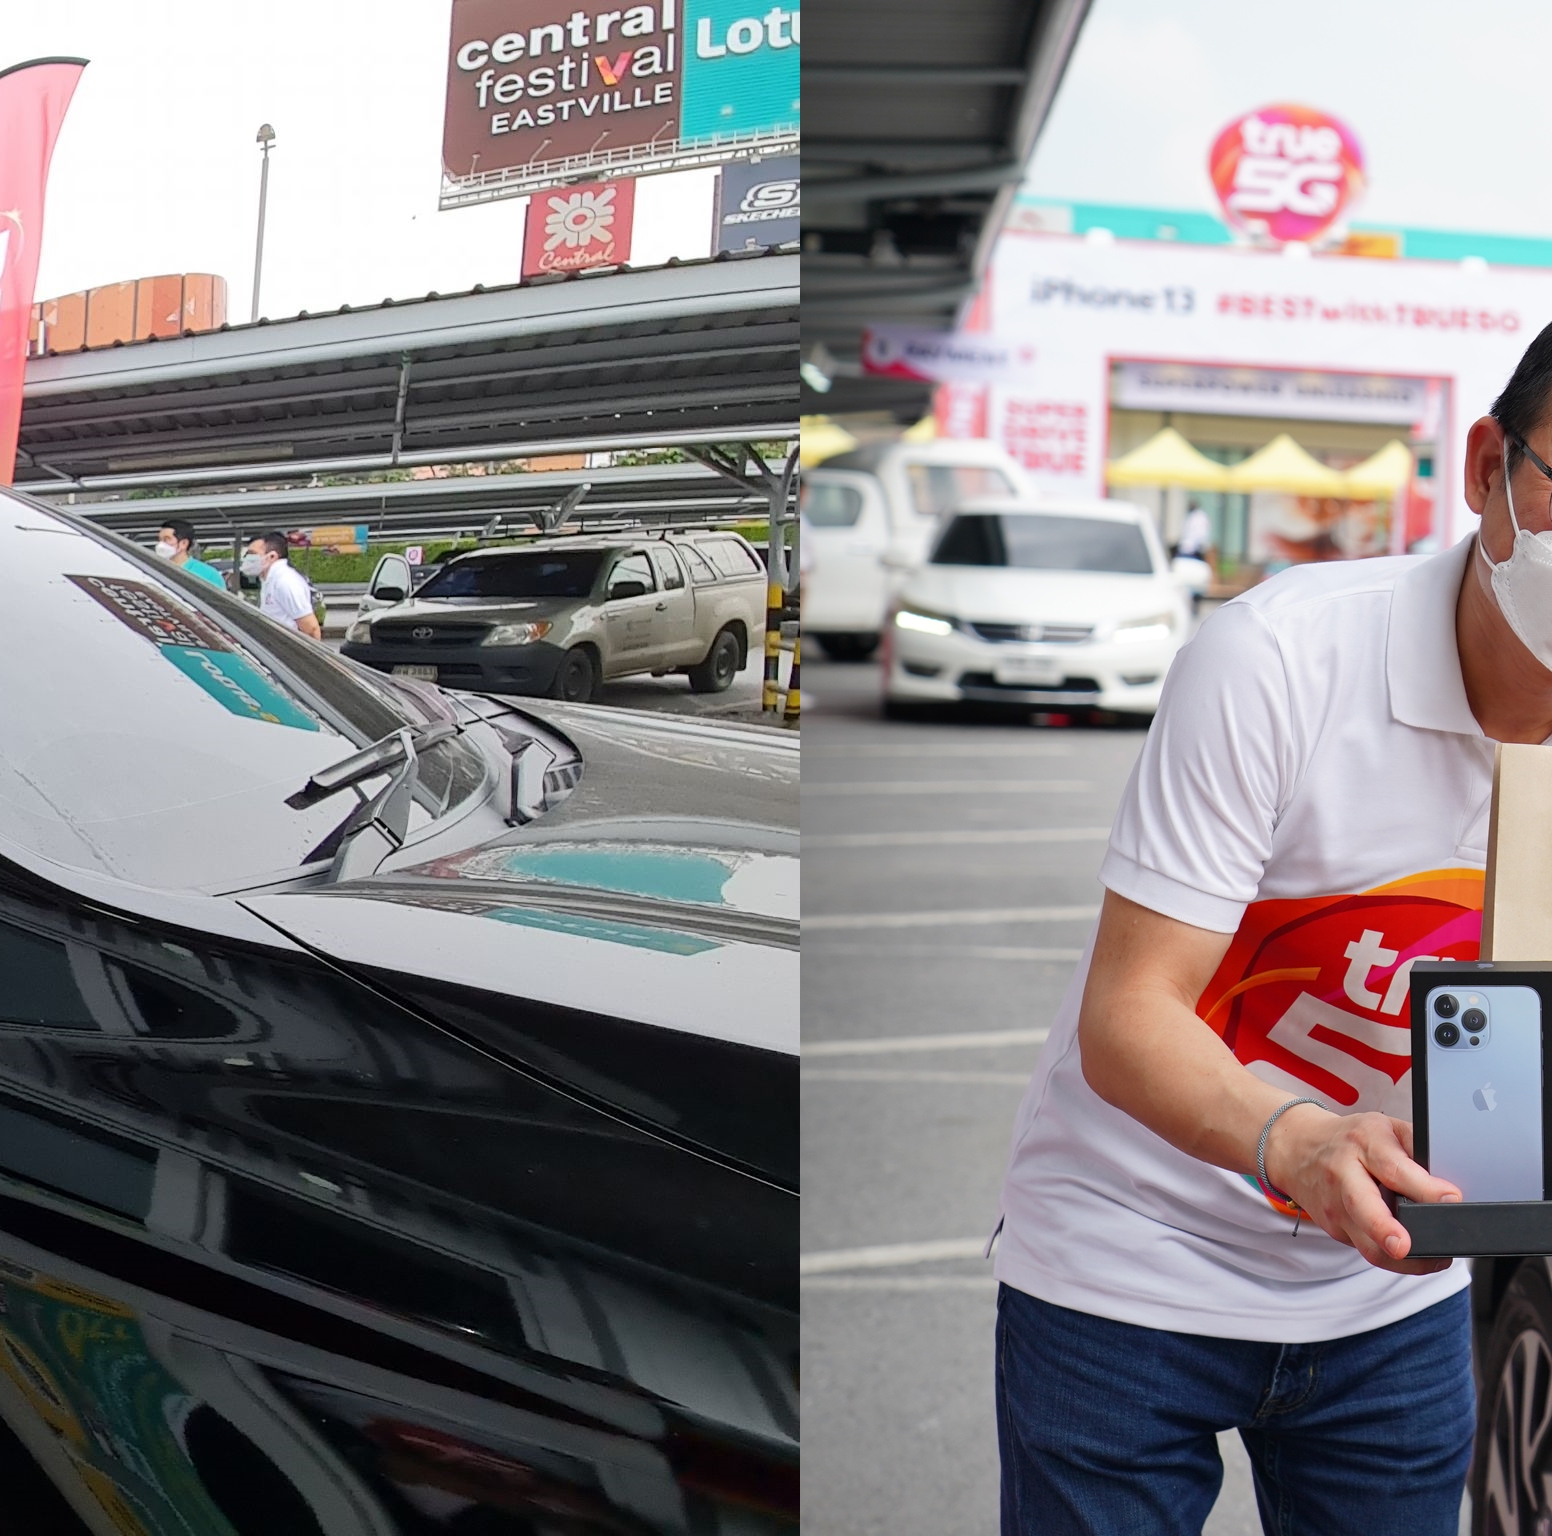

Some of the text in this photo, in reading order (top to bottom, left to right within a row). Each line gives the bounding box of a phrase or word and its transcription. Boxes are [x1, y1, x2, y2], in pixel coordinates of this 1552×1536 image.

[456, 0, 676, 72] central
[475, 33, 675, 109] festival
[491, 82, 674, 136] EASTVILLE
[1239, 116, 1343, 160] true
[1226, 159, 1344, 217] 5G
[539, 242, 616, 271] Central
